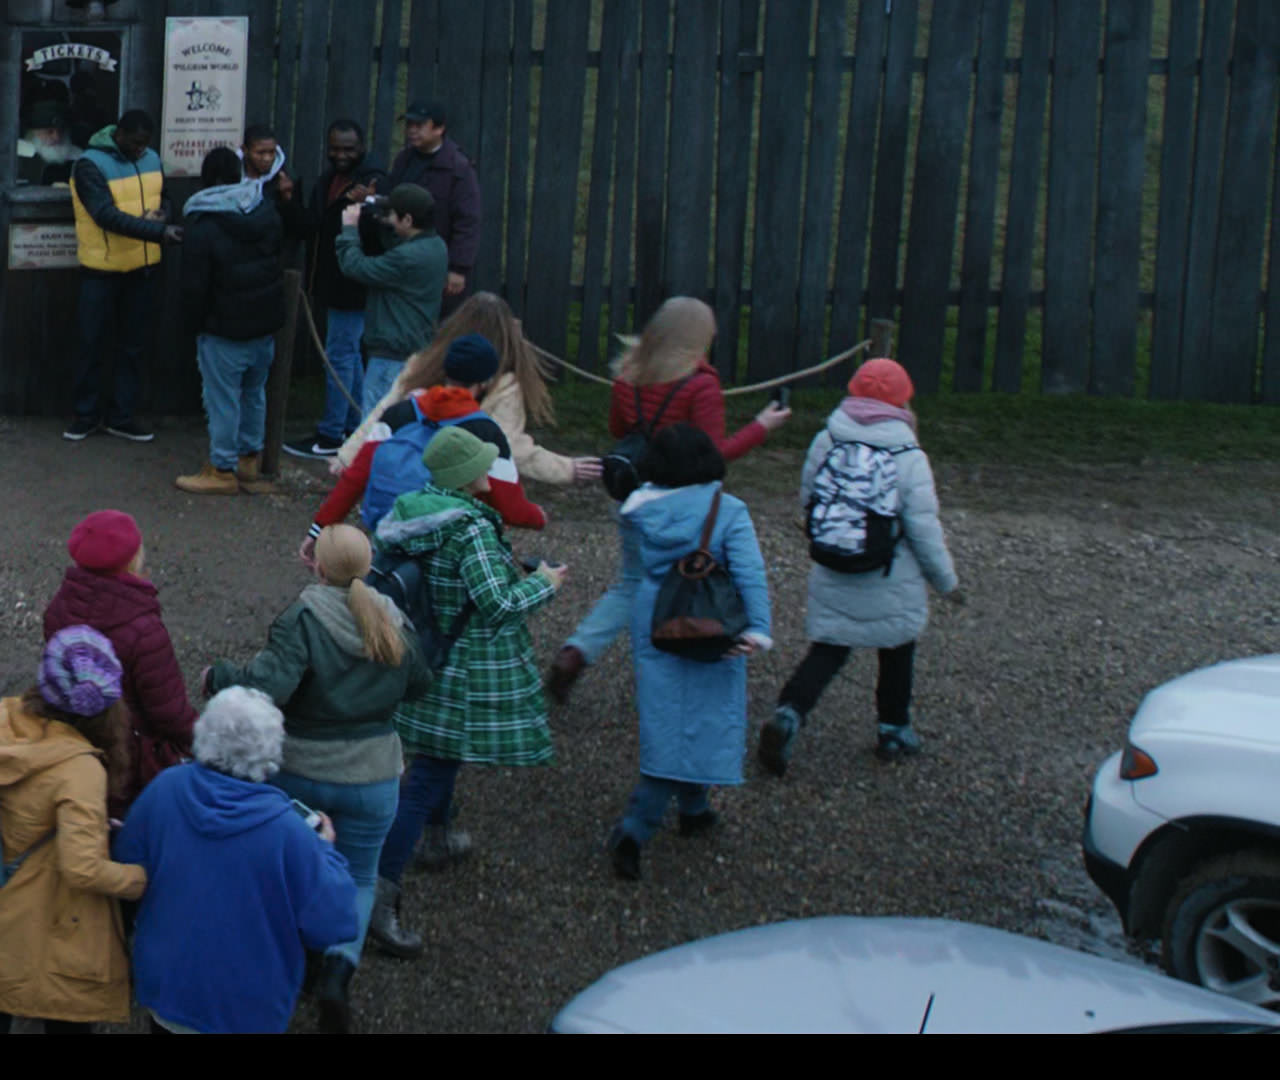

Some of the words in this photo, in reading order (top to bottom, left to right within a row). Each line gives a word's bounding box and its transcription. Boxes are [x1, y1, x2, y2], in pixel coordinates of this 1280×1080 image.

[41, 45, 104, 60] TICKETS
[181, 42, 232, 57] WELCOME
[173, 63, 208, 71] PILGRIM
